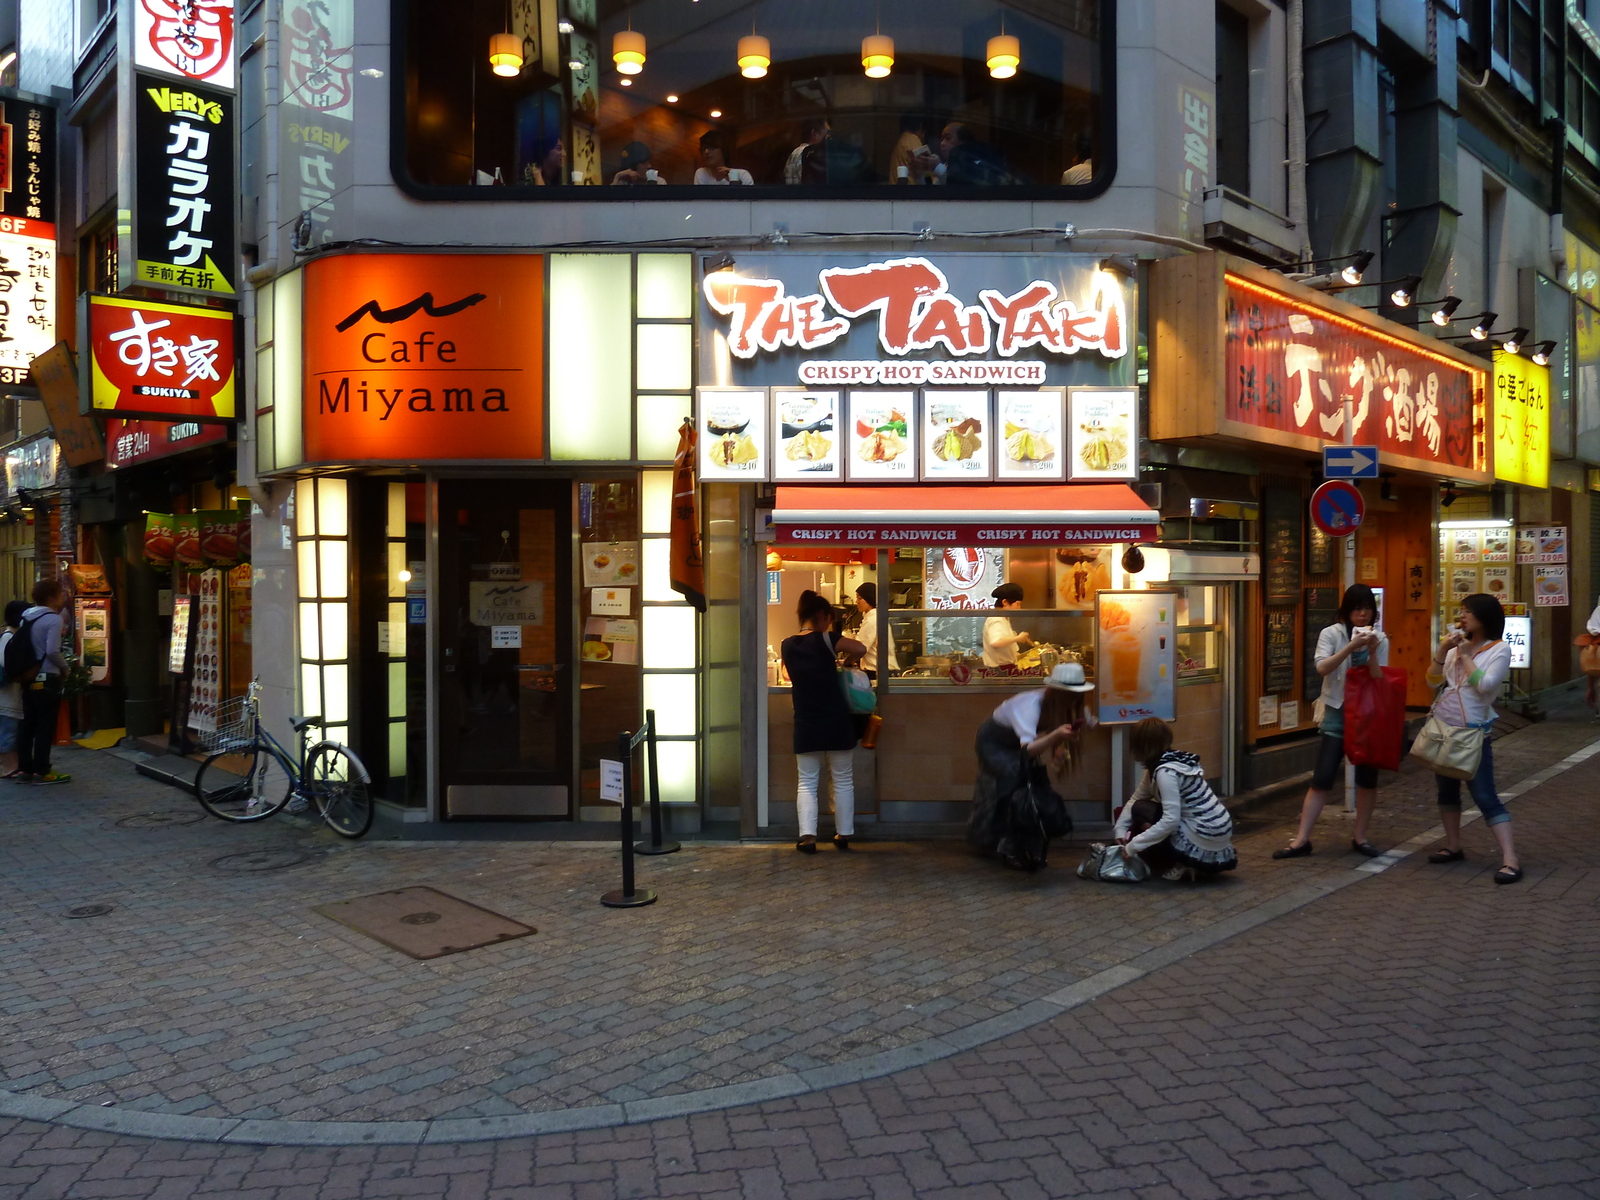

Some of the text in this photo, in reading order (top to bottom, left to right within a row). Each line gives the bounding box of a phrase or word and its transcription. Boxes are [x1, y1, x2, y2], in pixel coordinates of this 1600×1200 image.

[146, 87, 225, 125] VERY'S
[165, 121, 213, 266] カラオケ
[146, 266, 215, 290] 手前右折
[705, 258, 1128, 358] THE TAIYAKI
[109, 310, 220, 387] すき家
[361, 331, 457, 363] Cafe
[803, 365, 1040, 380] CRISPY HOT SANDWICH
[141, 386, 191, 398] SUKIYA
[319, 377, 510, 421] Miyama
[1497, 370, 1545, 411] 中華ごはん
[170, 422, 199, 442] SUKIYA
[791, 529, 957, 541] CRISPY HOT SANDWICH
[976, 529, 1141, 540] CRISPY HOT SANDWICH
[491, 567, 520, 575] OPEN
[1410, 565, 1423, 603] 商い中
[493, 596, 521, 607] Cafe
[477, 609, 537, 622] Miyama
